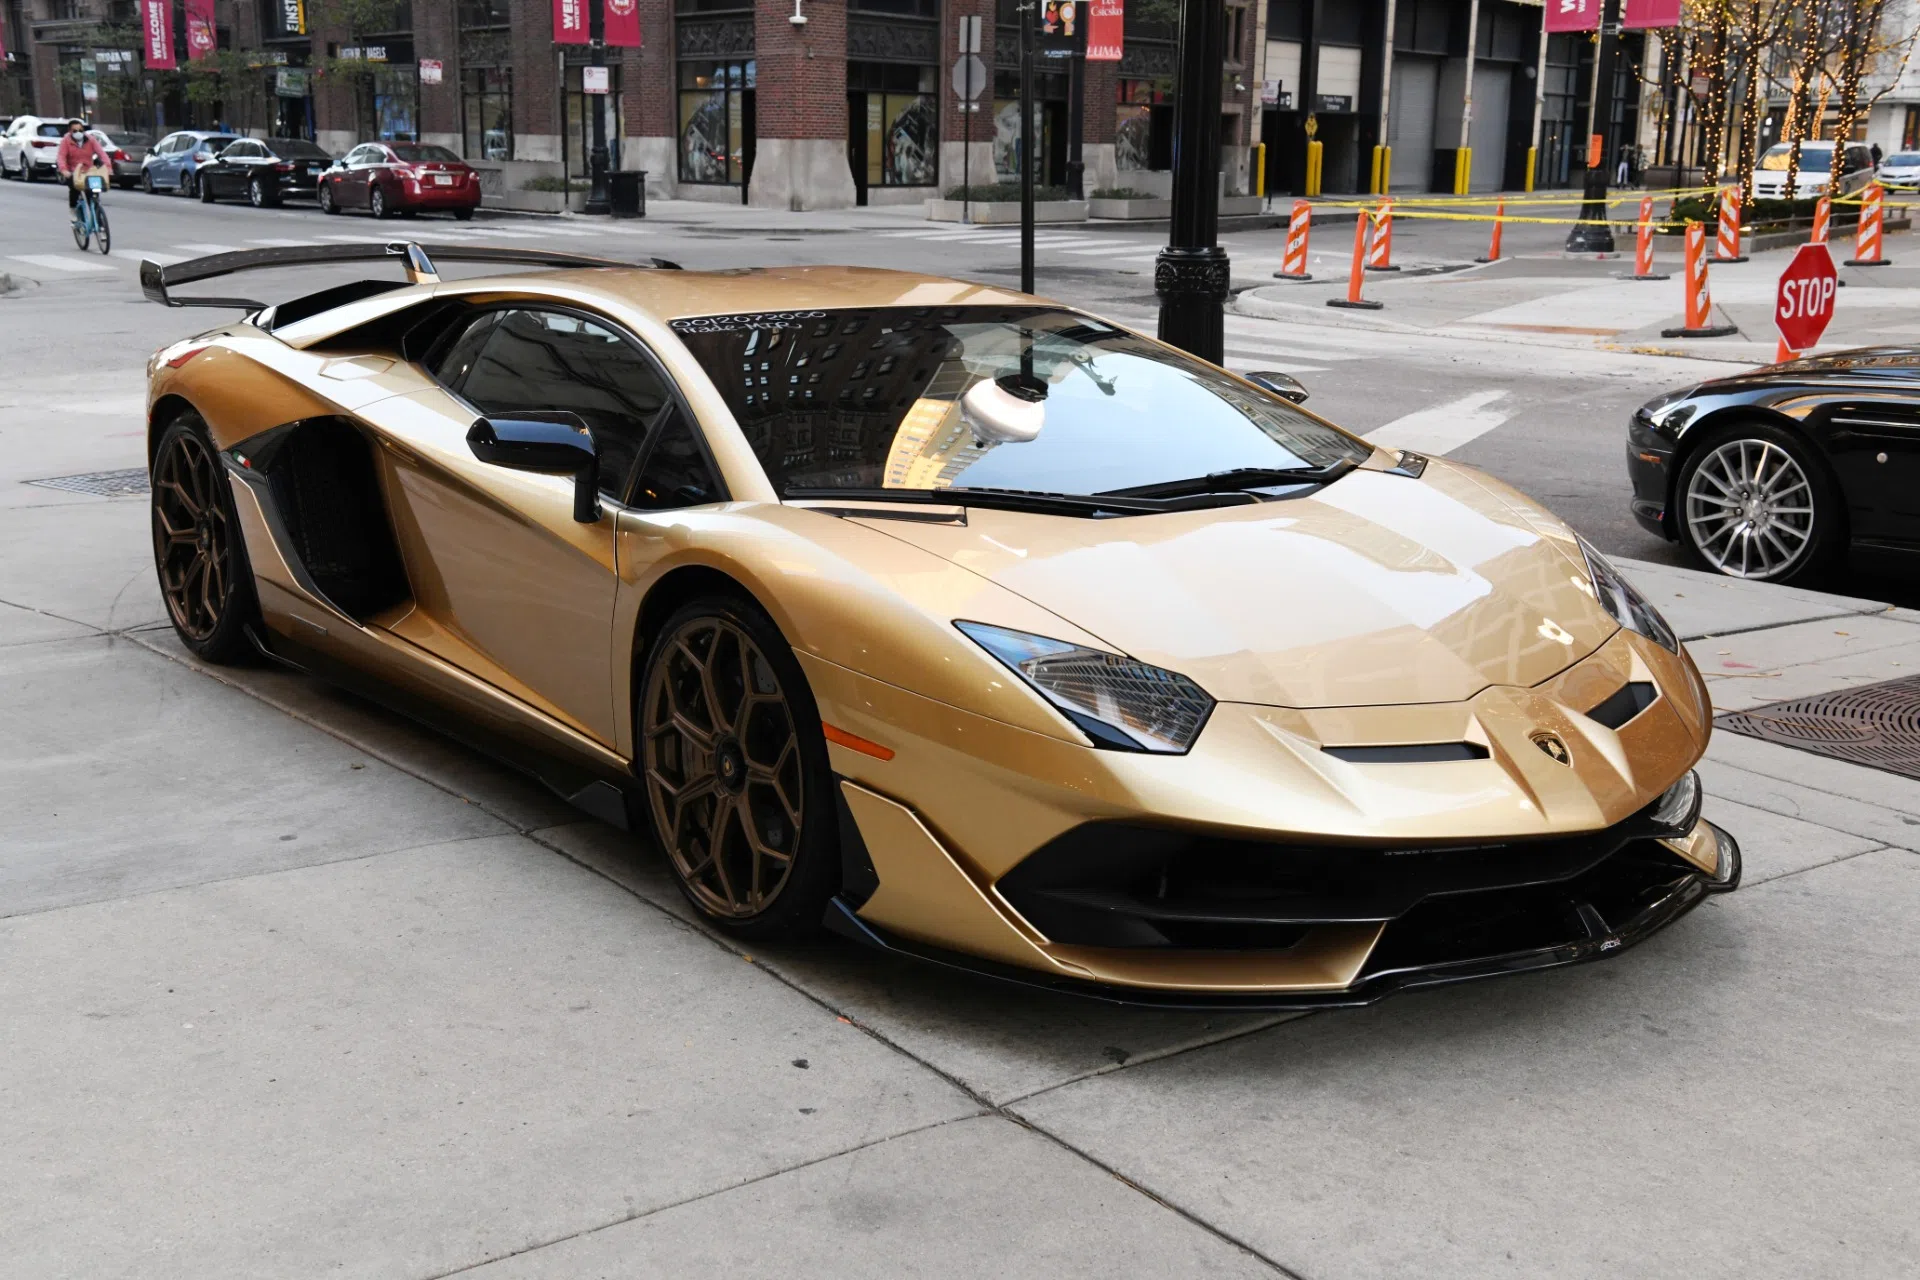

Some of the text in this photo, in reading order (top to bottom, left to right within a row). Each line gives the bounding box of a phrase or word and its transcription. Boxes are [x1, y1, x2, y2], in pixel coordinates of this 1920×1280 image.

[149, 1, 162, 59] WELCOME
[285, 0, 299, 31] EINST
[1086, 45, 1123, 58] LUMA
[1780, 277, 1835, 319] STOP
